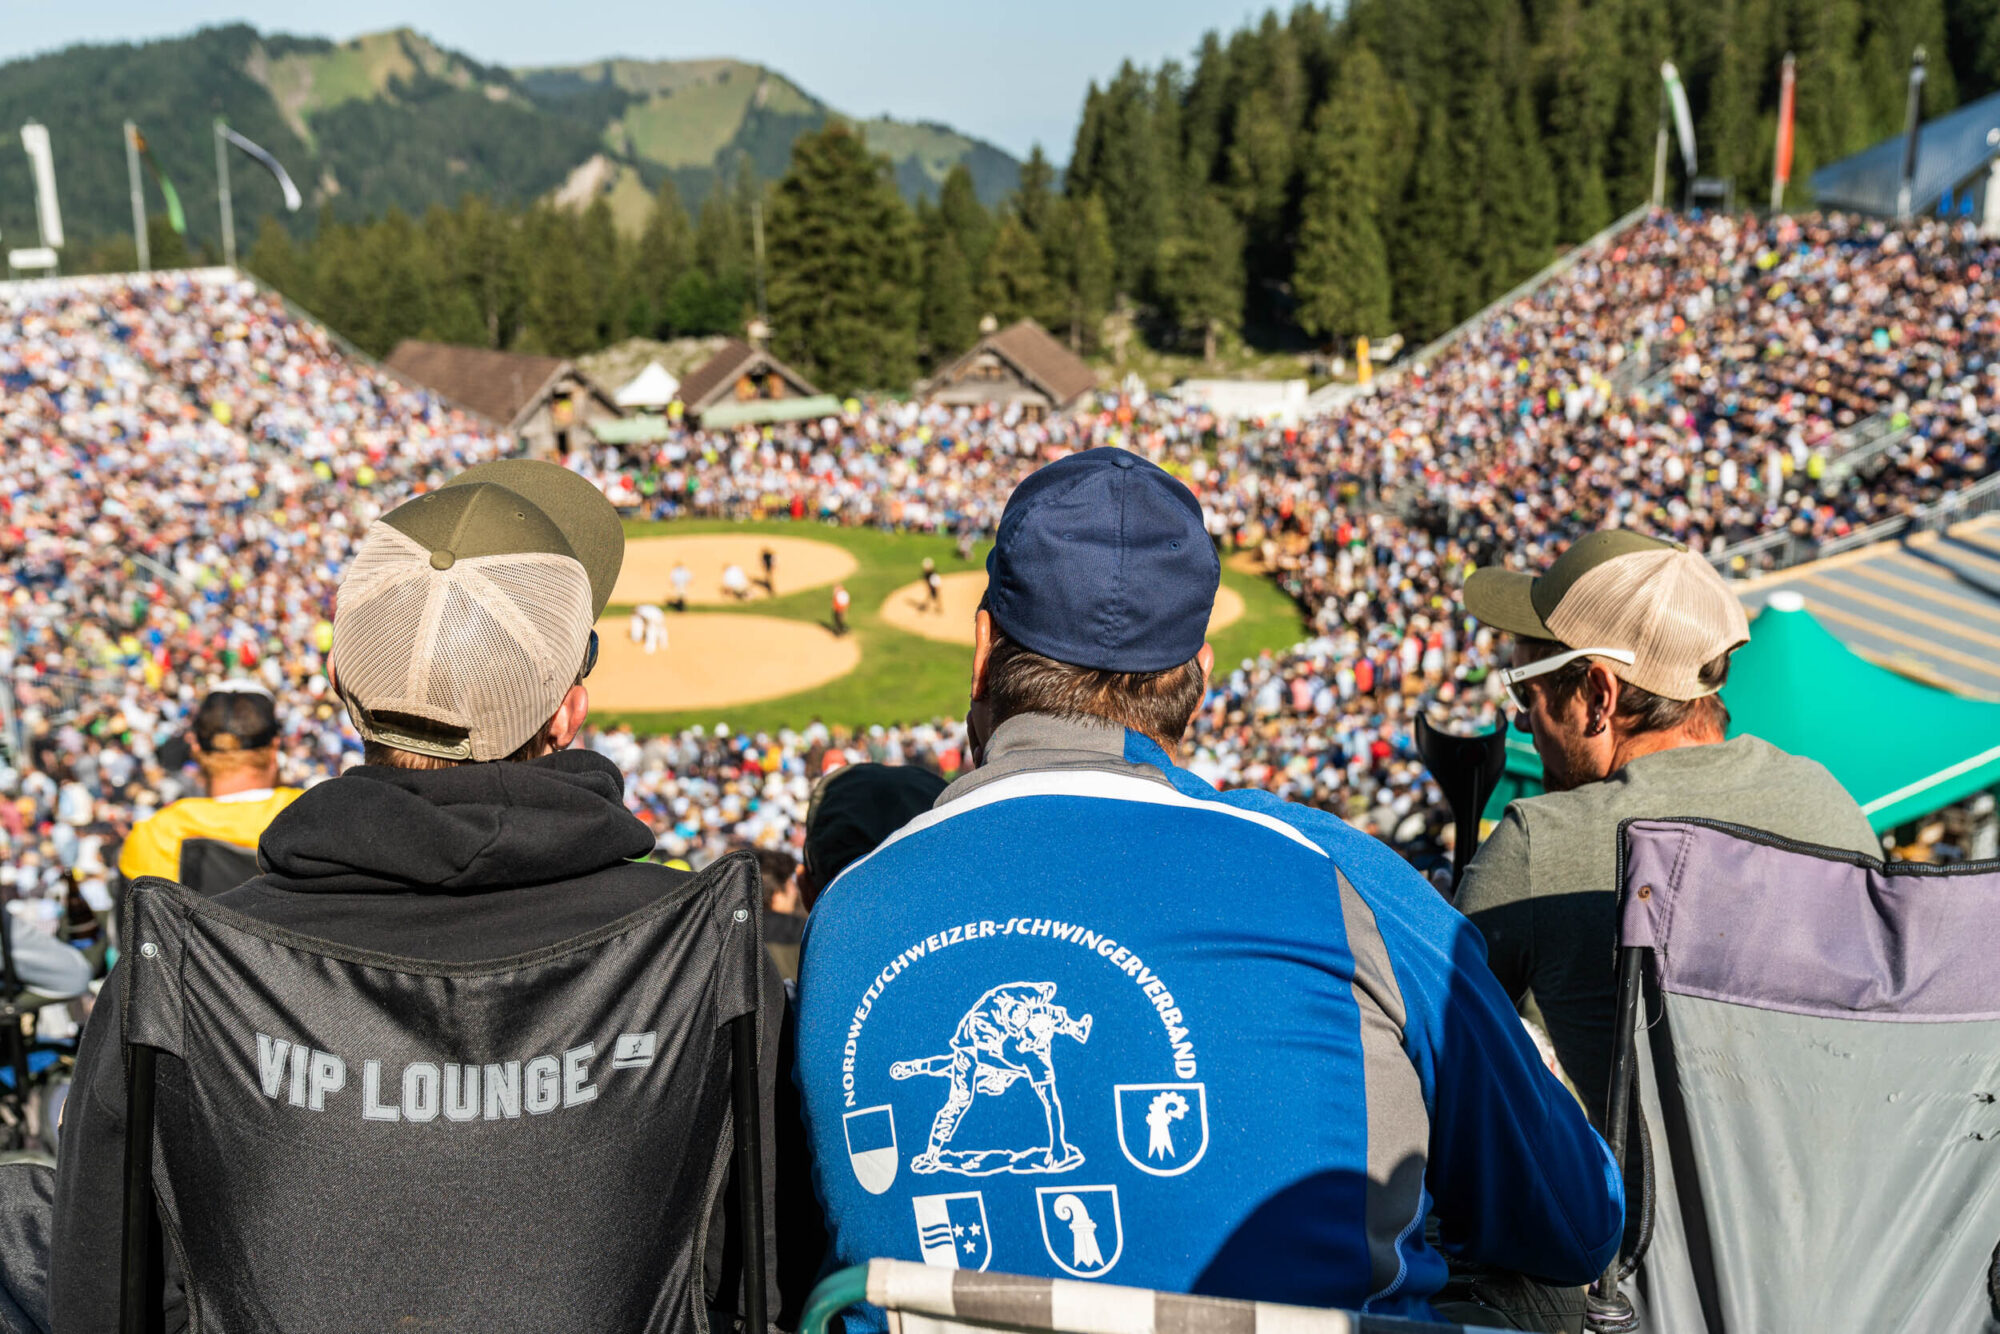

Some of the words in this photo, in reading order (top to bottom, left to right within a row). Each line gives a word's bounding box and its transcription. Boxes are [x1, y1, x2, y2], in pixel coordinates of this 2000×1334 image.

[256, 1032, 346, 1112] VIP
[362, 1041, 598, 1122] LOUNGE
[842, 918, 1197, 1108] NORDWESTSCHWEIZER-SCHWINGERVERBAND
